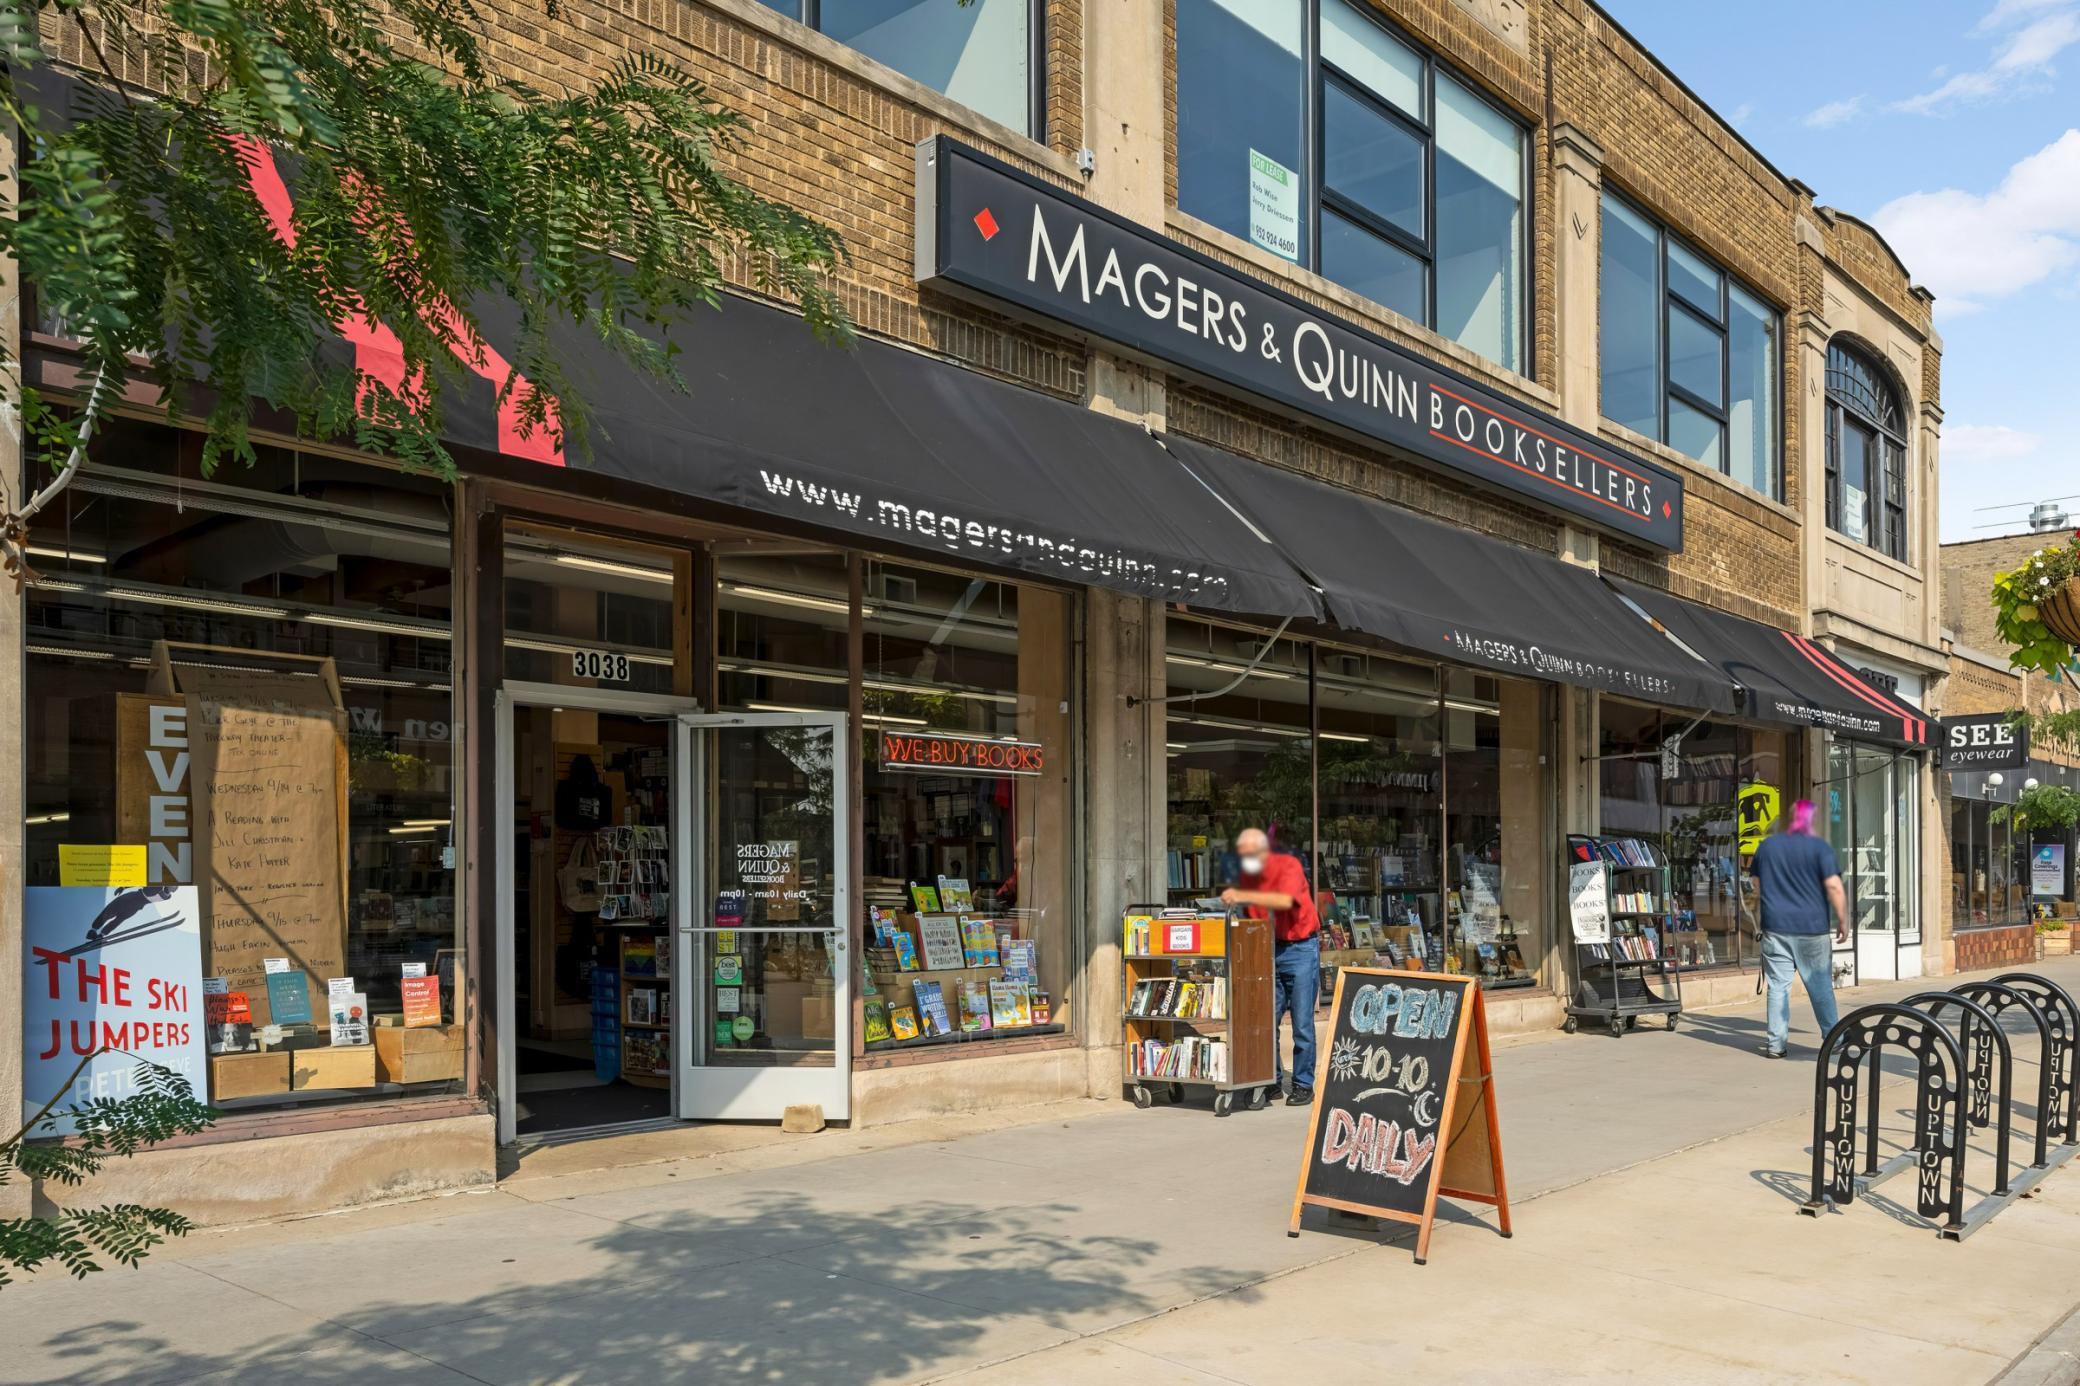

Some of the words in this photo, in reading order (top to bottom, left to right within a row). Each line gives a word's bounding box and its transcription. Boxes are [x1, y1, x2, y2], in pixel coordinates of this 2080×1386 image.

[1252, 155, 1265, 171] FOR
[1265, 161, 1284, 182] LEASE
[1255, 224, 1266, 240] 952
[1266, 231, 1277, 247] 924
[1278, 238, 1295, 253] 4600
[1027, 203, 1248, 353] MAGERS
[1261, 322, 1282, 364] &
[1293, 321, 1418, 425] QUINN
[1430, 392, 1652, 517] BOOKSELLERS
[574, 651, 628, 680] 3038
[1950, 722, 2014, 748] SEE
[885, 736, 923, 762] WE
[930, 741, 970, 765] BUY
[976, 744, 1043, 769] BOOKS
[1950, 748, 2014, 764] eyewear
[207, 809, 216, 828] A
[225, 811, 264, 825] READING
[1572, 884, 1603, 894] BOOKS
[1574, 900, 1604, 910] BOOKS
[32, 946, 132, 1007] THE
[148, 978, 188, 1012] SKI
[1350, 982, 1458, 1040] OPEN
[40, 1020, 190, 1060] JUMPERS
[1359, 1043, 1429, 1093] 10-10
[1320, 1106, 1436, 1186] DAILY
[1835, 1085, 1854, 1193] UPTOWN
[1921, 1094, 1942, 1206] UPTOWN
